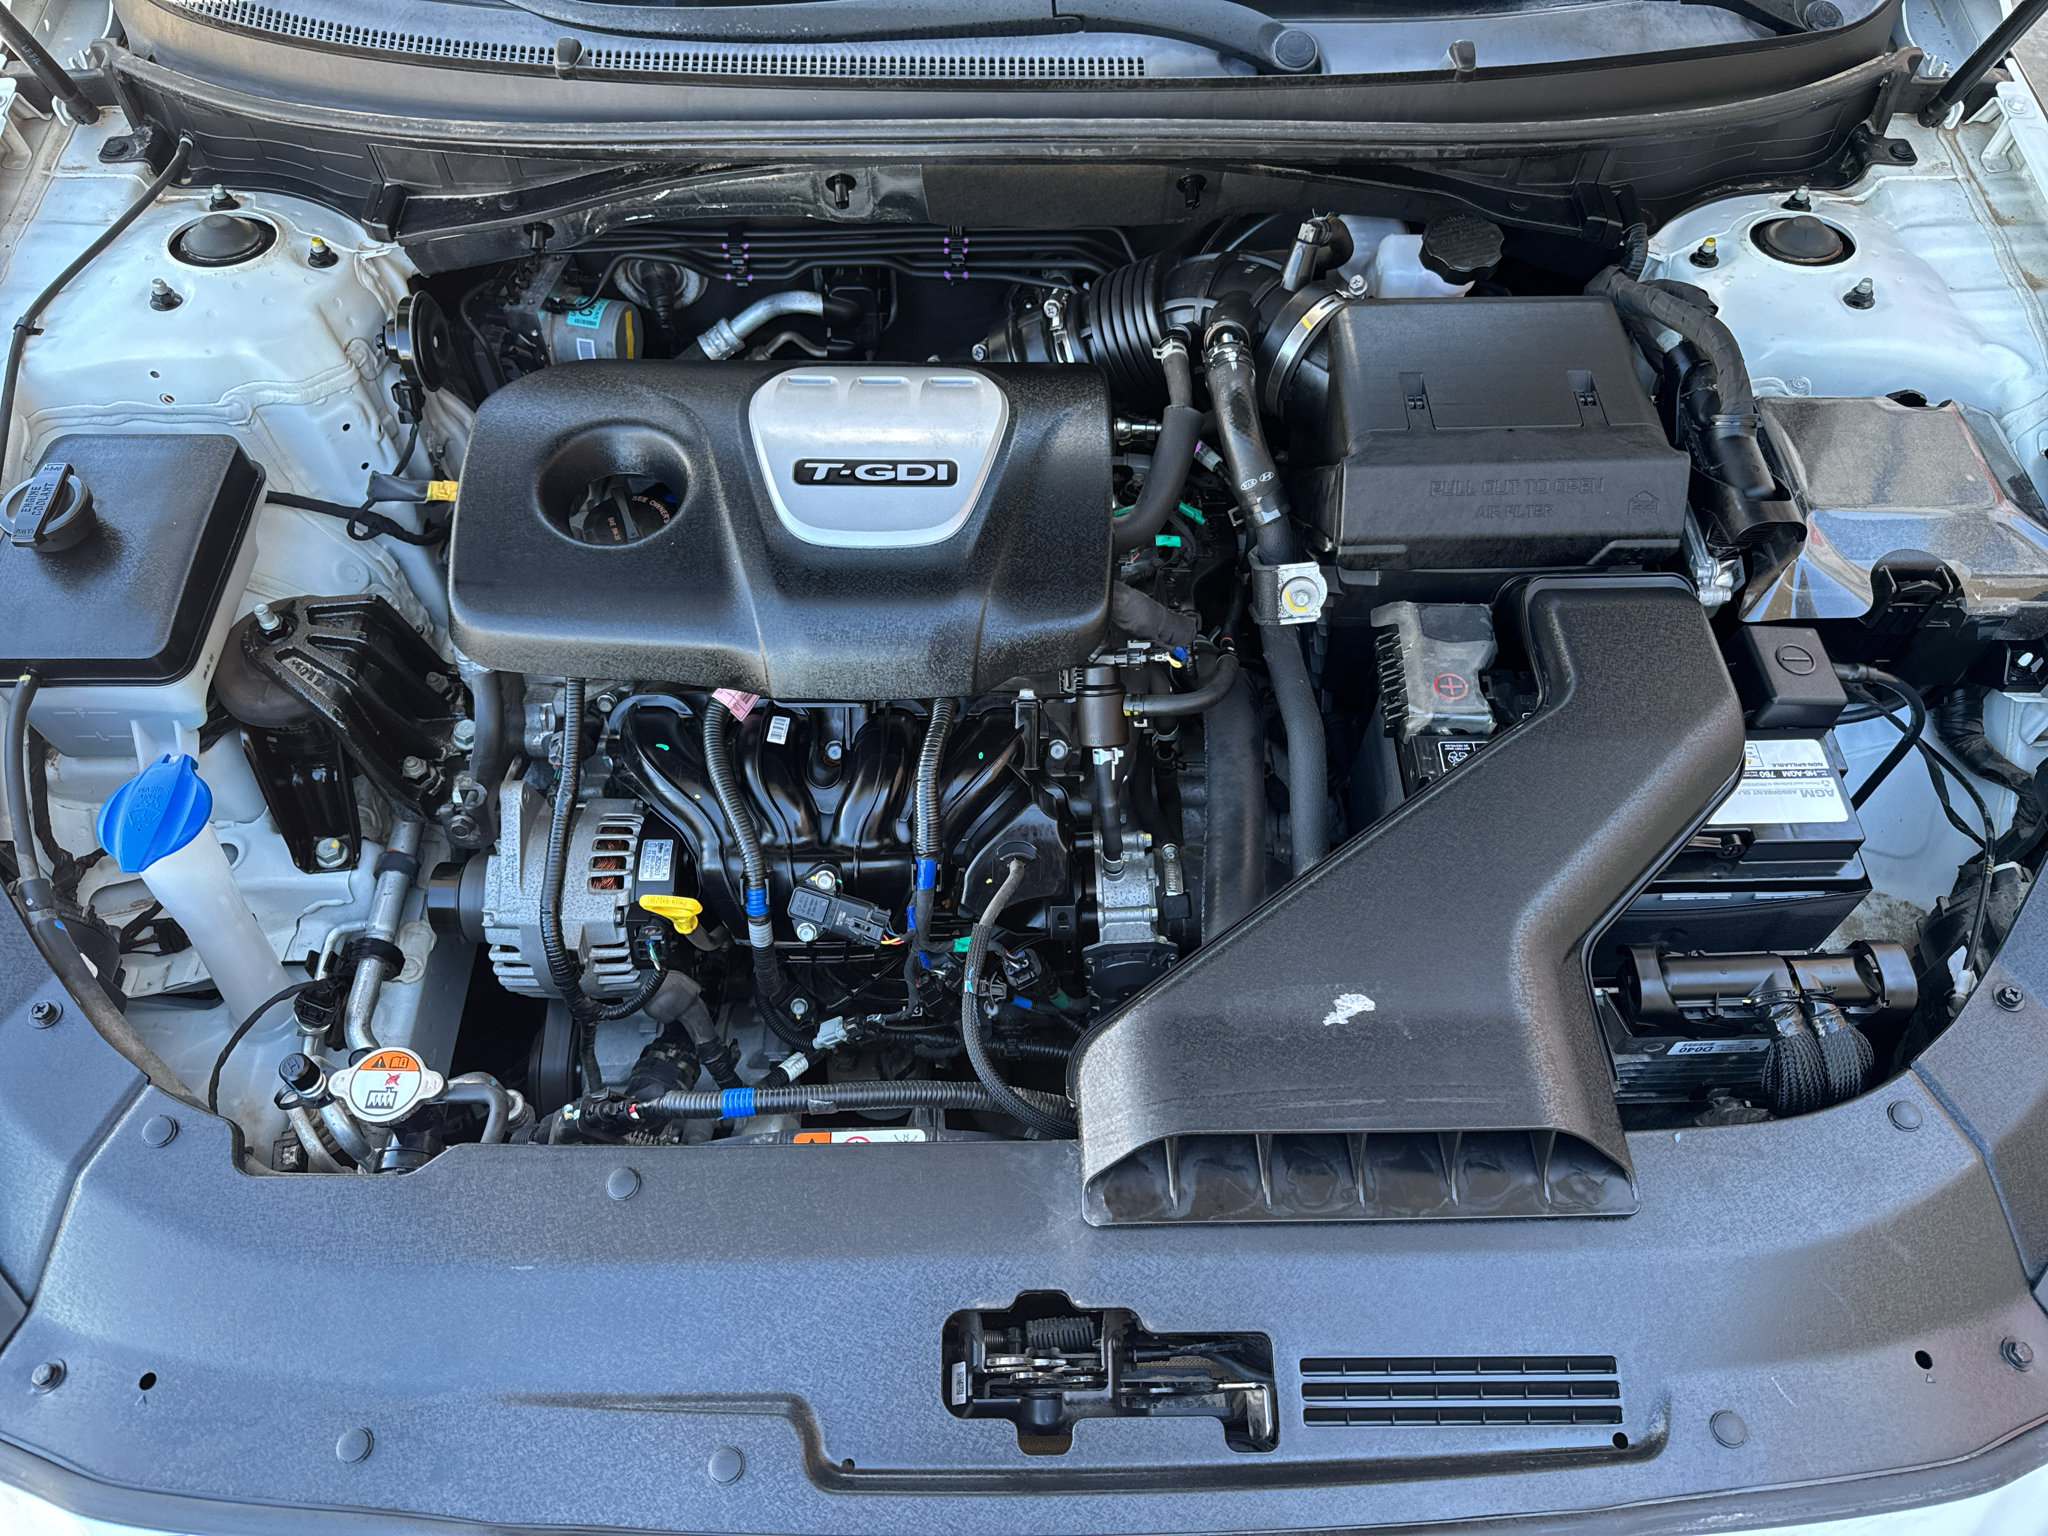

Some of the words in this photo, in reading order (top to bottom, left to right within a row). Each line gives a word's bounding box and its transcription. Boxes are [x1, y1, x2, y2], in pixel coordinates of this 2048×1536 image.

[803, 462, 949, 481] T-GDI
[1430, 480, 1477, 497] PULL
[1482, 479, 1520, 496] OUT
[1523, 479, 1549, 495] TO
[1554, 477, 1605, 495] OPEN
[21, 486, 42, 513] ENGINE
[32, 482, 55, 516] COOLANT
[1475, 504, 1500, 520] AIR
[1504, 503, 1555, 519] FILTER
[1800, 789, 1835, 798] AGM
